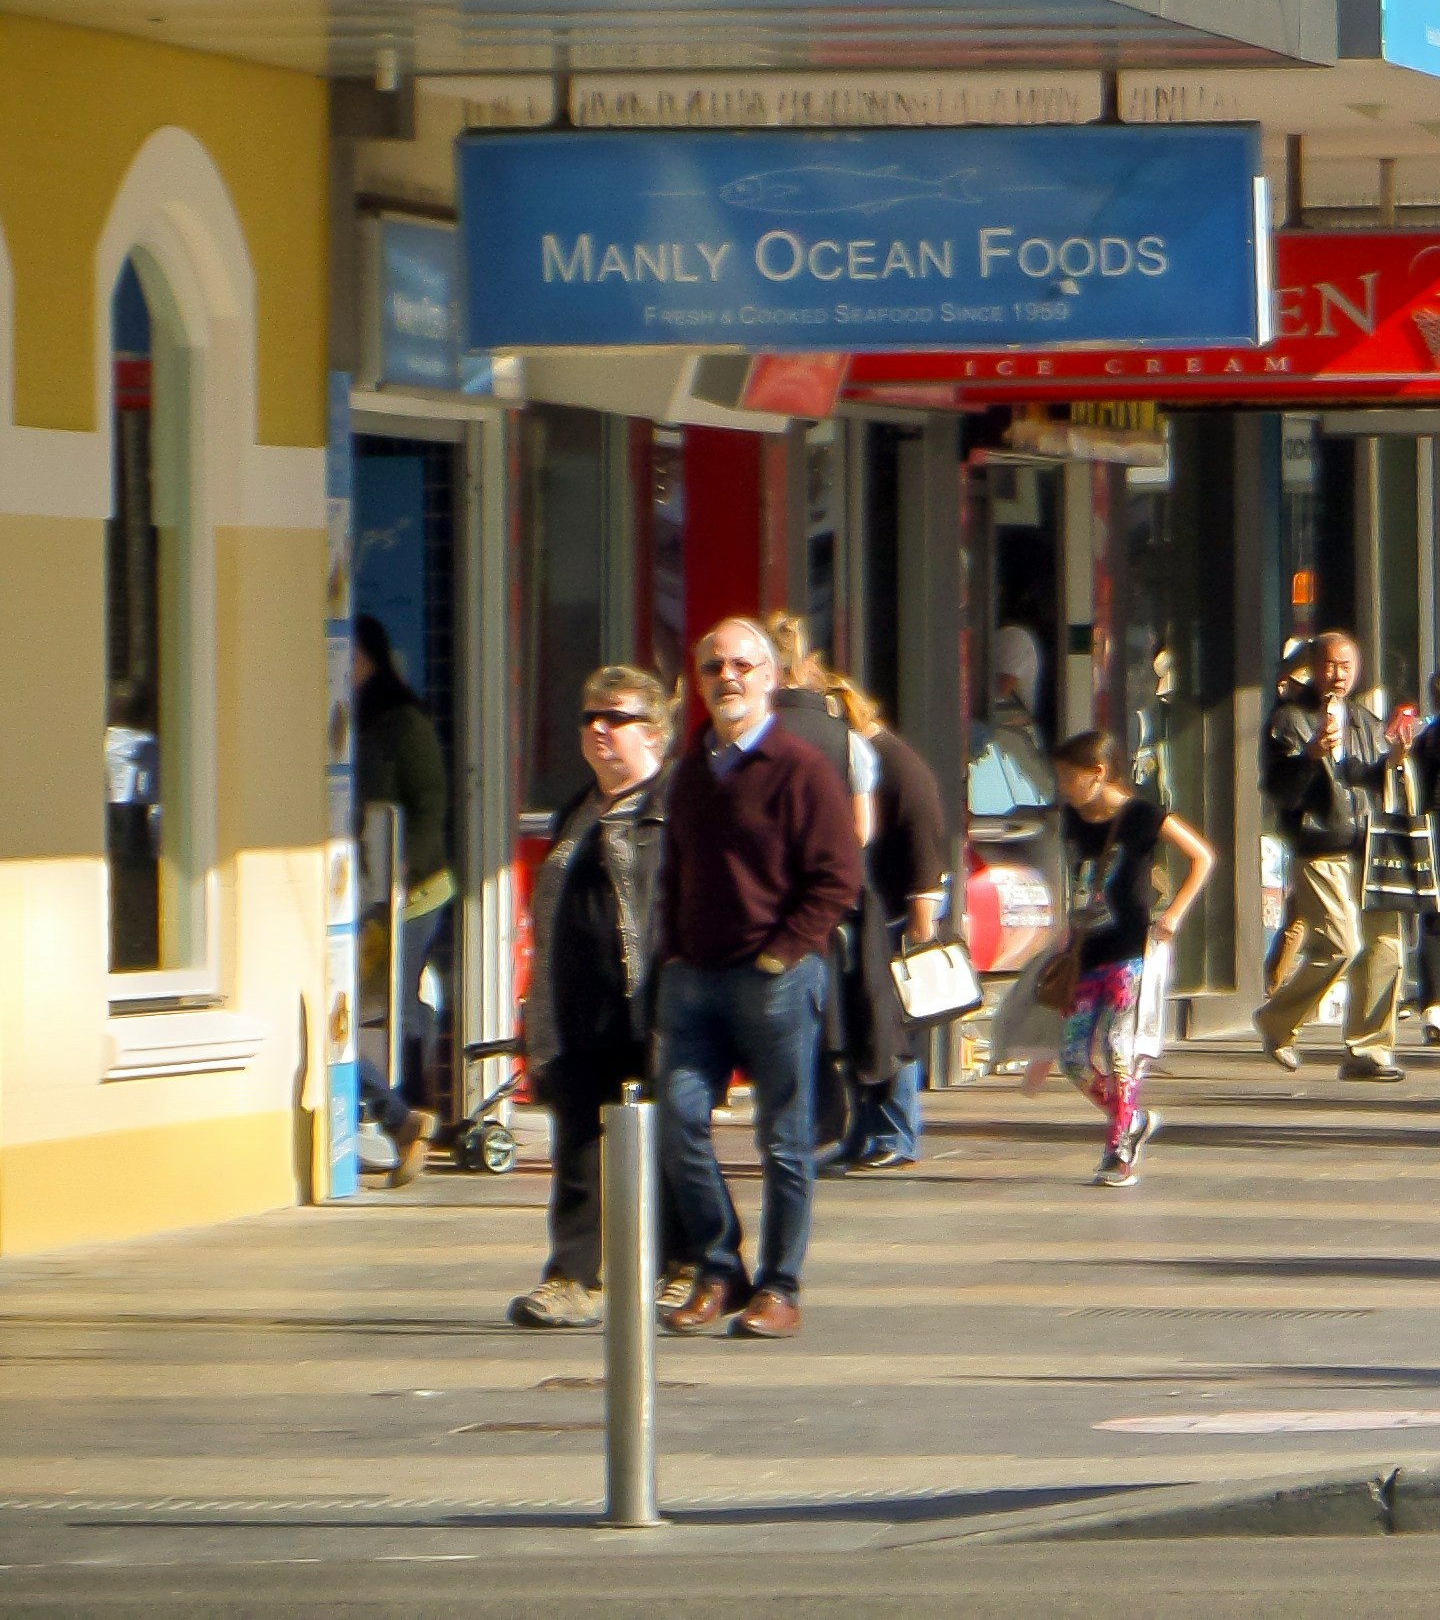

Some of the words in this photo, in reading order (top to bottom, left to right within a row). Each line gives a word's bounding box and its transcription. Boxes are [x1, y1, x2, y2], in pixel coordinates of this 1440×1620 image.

[541, 233, 733, 283] MANLY
[755, 229, 952, 282] OCEAN
[979, 227, 1169, 279] FOODS
[965, 359, 1055, 377] ICE
[1103, 354, 1293, 376] CREAM
